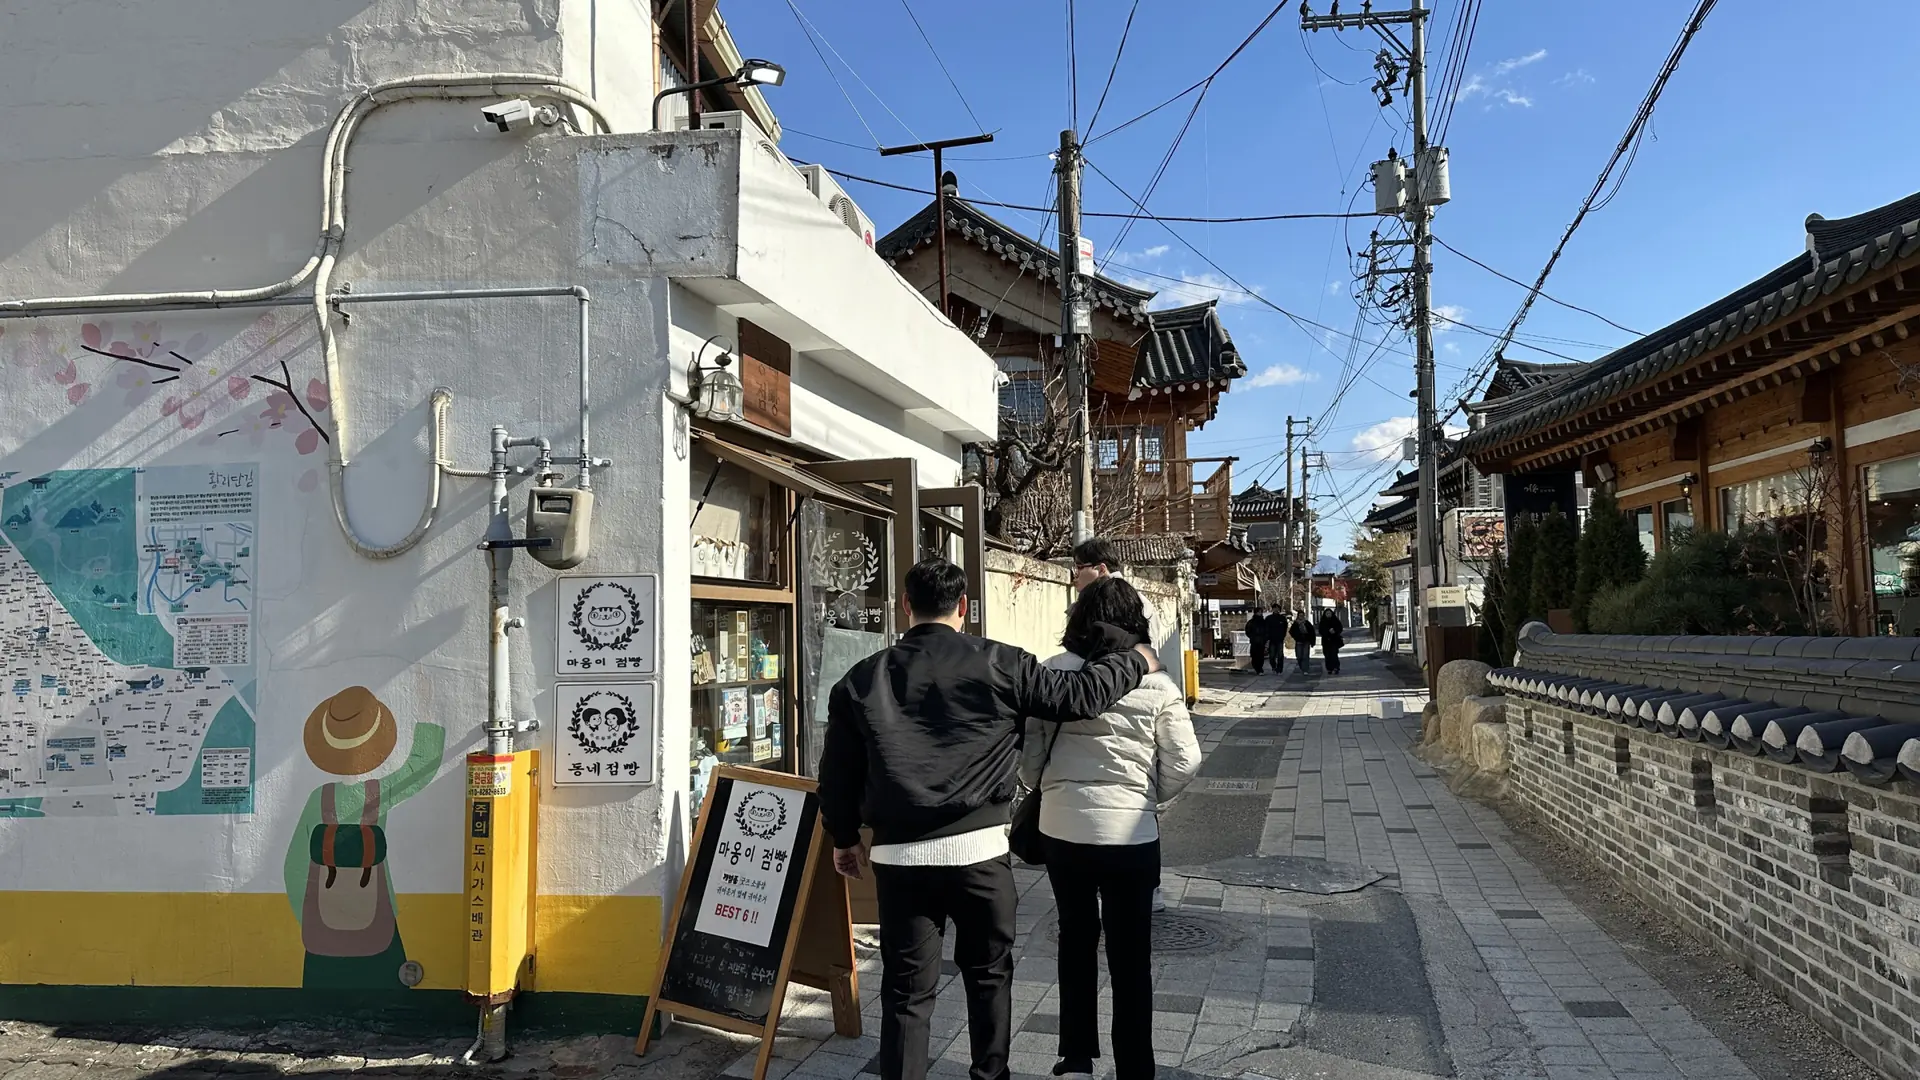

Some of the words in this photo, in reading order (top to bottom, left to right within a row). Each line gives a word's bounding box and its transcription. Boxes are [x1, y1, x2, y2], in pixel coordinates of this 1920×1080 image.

[208, 468, 253, 489] 황리단길
[857, 608, 883, 625] 점빵
[615, 656, 643, 668] 점빵
[474, 804, 488, 835] 주의
[718, 841, 756, 865] 마옹이
[761, 848, 788, 873] 점빵
[471, 844, 486, 941] 도시가스배관
[714, 903, 742, 920] BEST
[742, 909, 750, 922] 6
